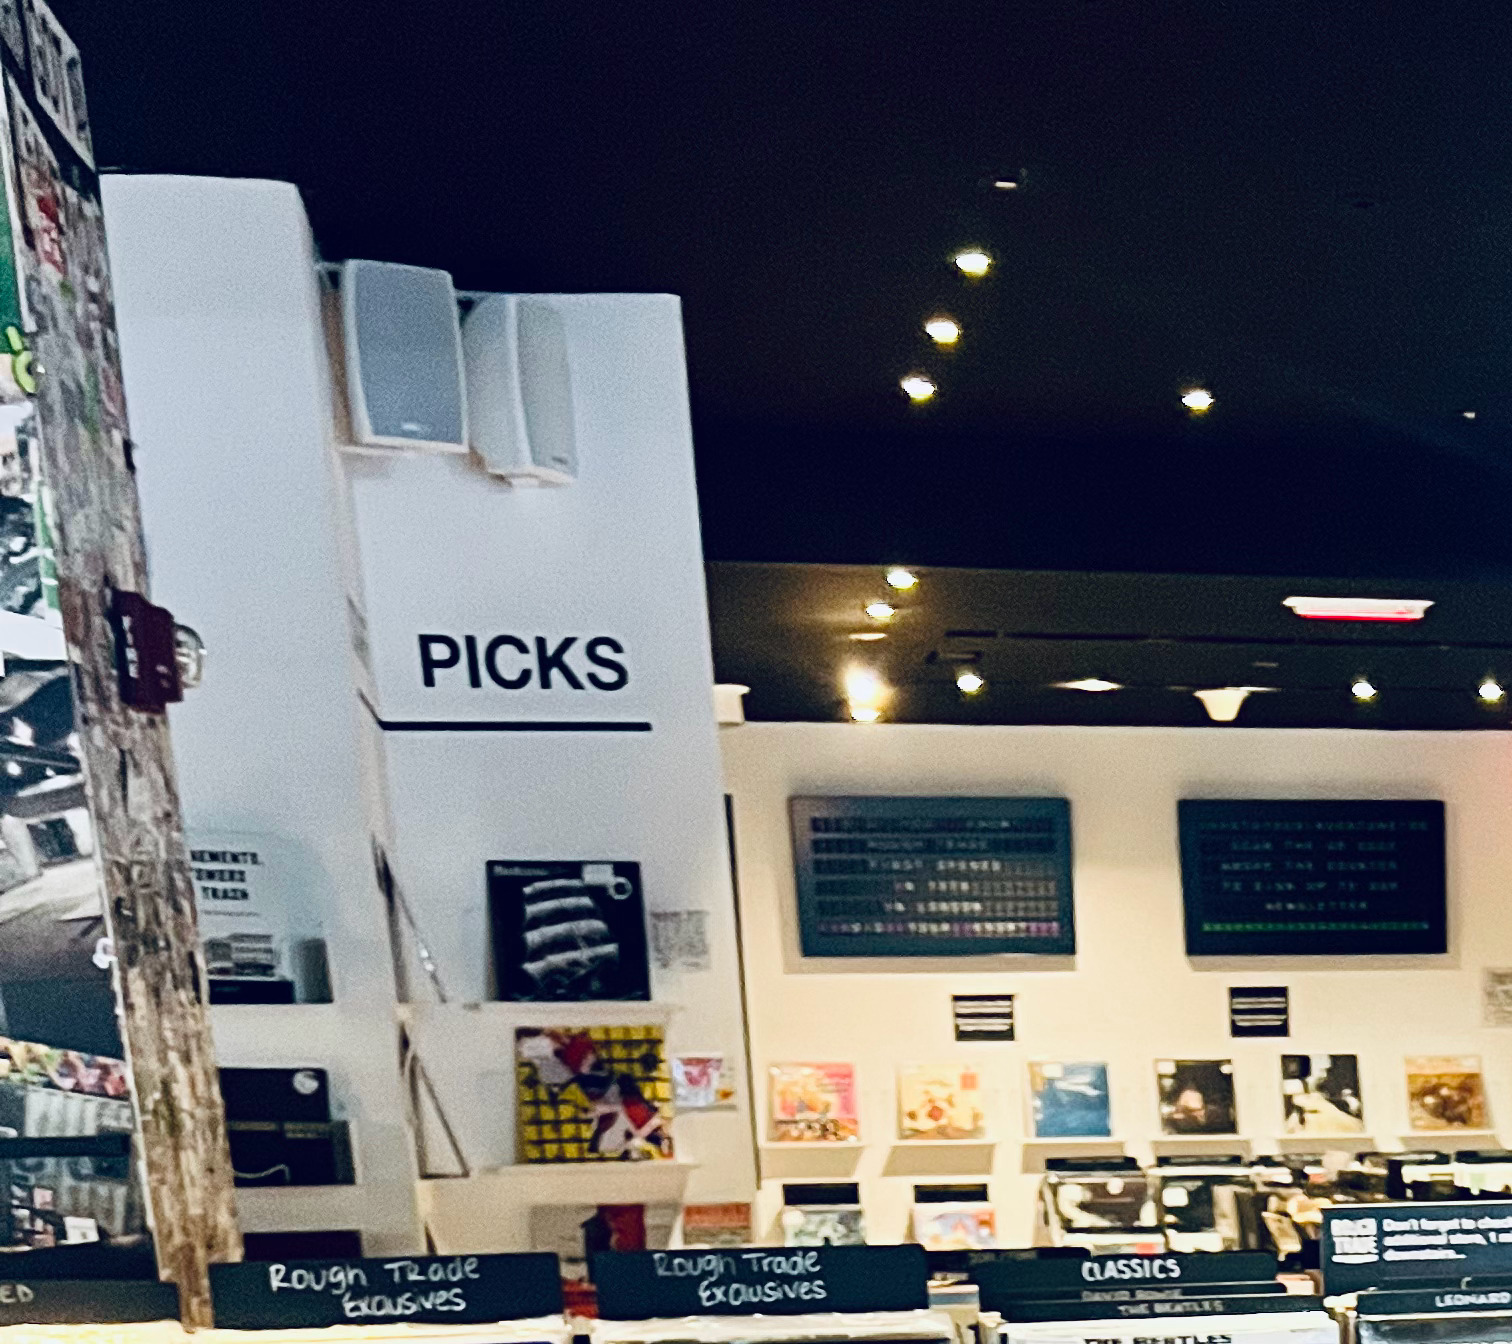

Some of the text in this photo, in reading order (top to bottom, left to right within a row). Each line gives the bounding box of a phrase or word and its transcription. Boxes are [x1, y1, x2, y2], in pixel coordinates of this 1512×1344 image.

[417, 633, 630, 692] PICKS
[269, 1257, 481, 1294] Rough Trade
[653, 1249, 822, 1281] Rough Trade
[1081, 1258, 1182, 1281] CLASSICS
[0, 1284, 34, 1303] ED
[1435, 1292, 1511, 1307] LEONARD
